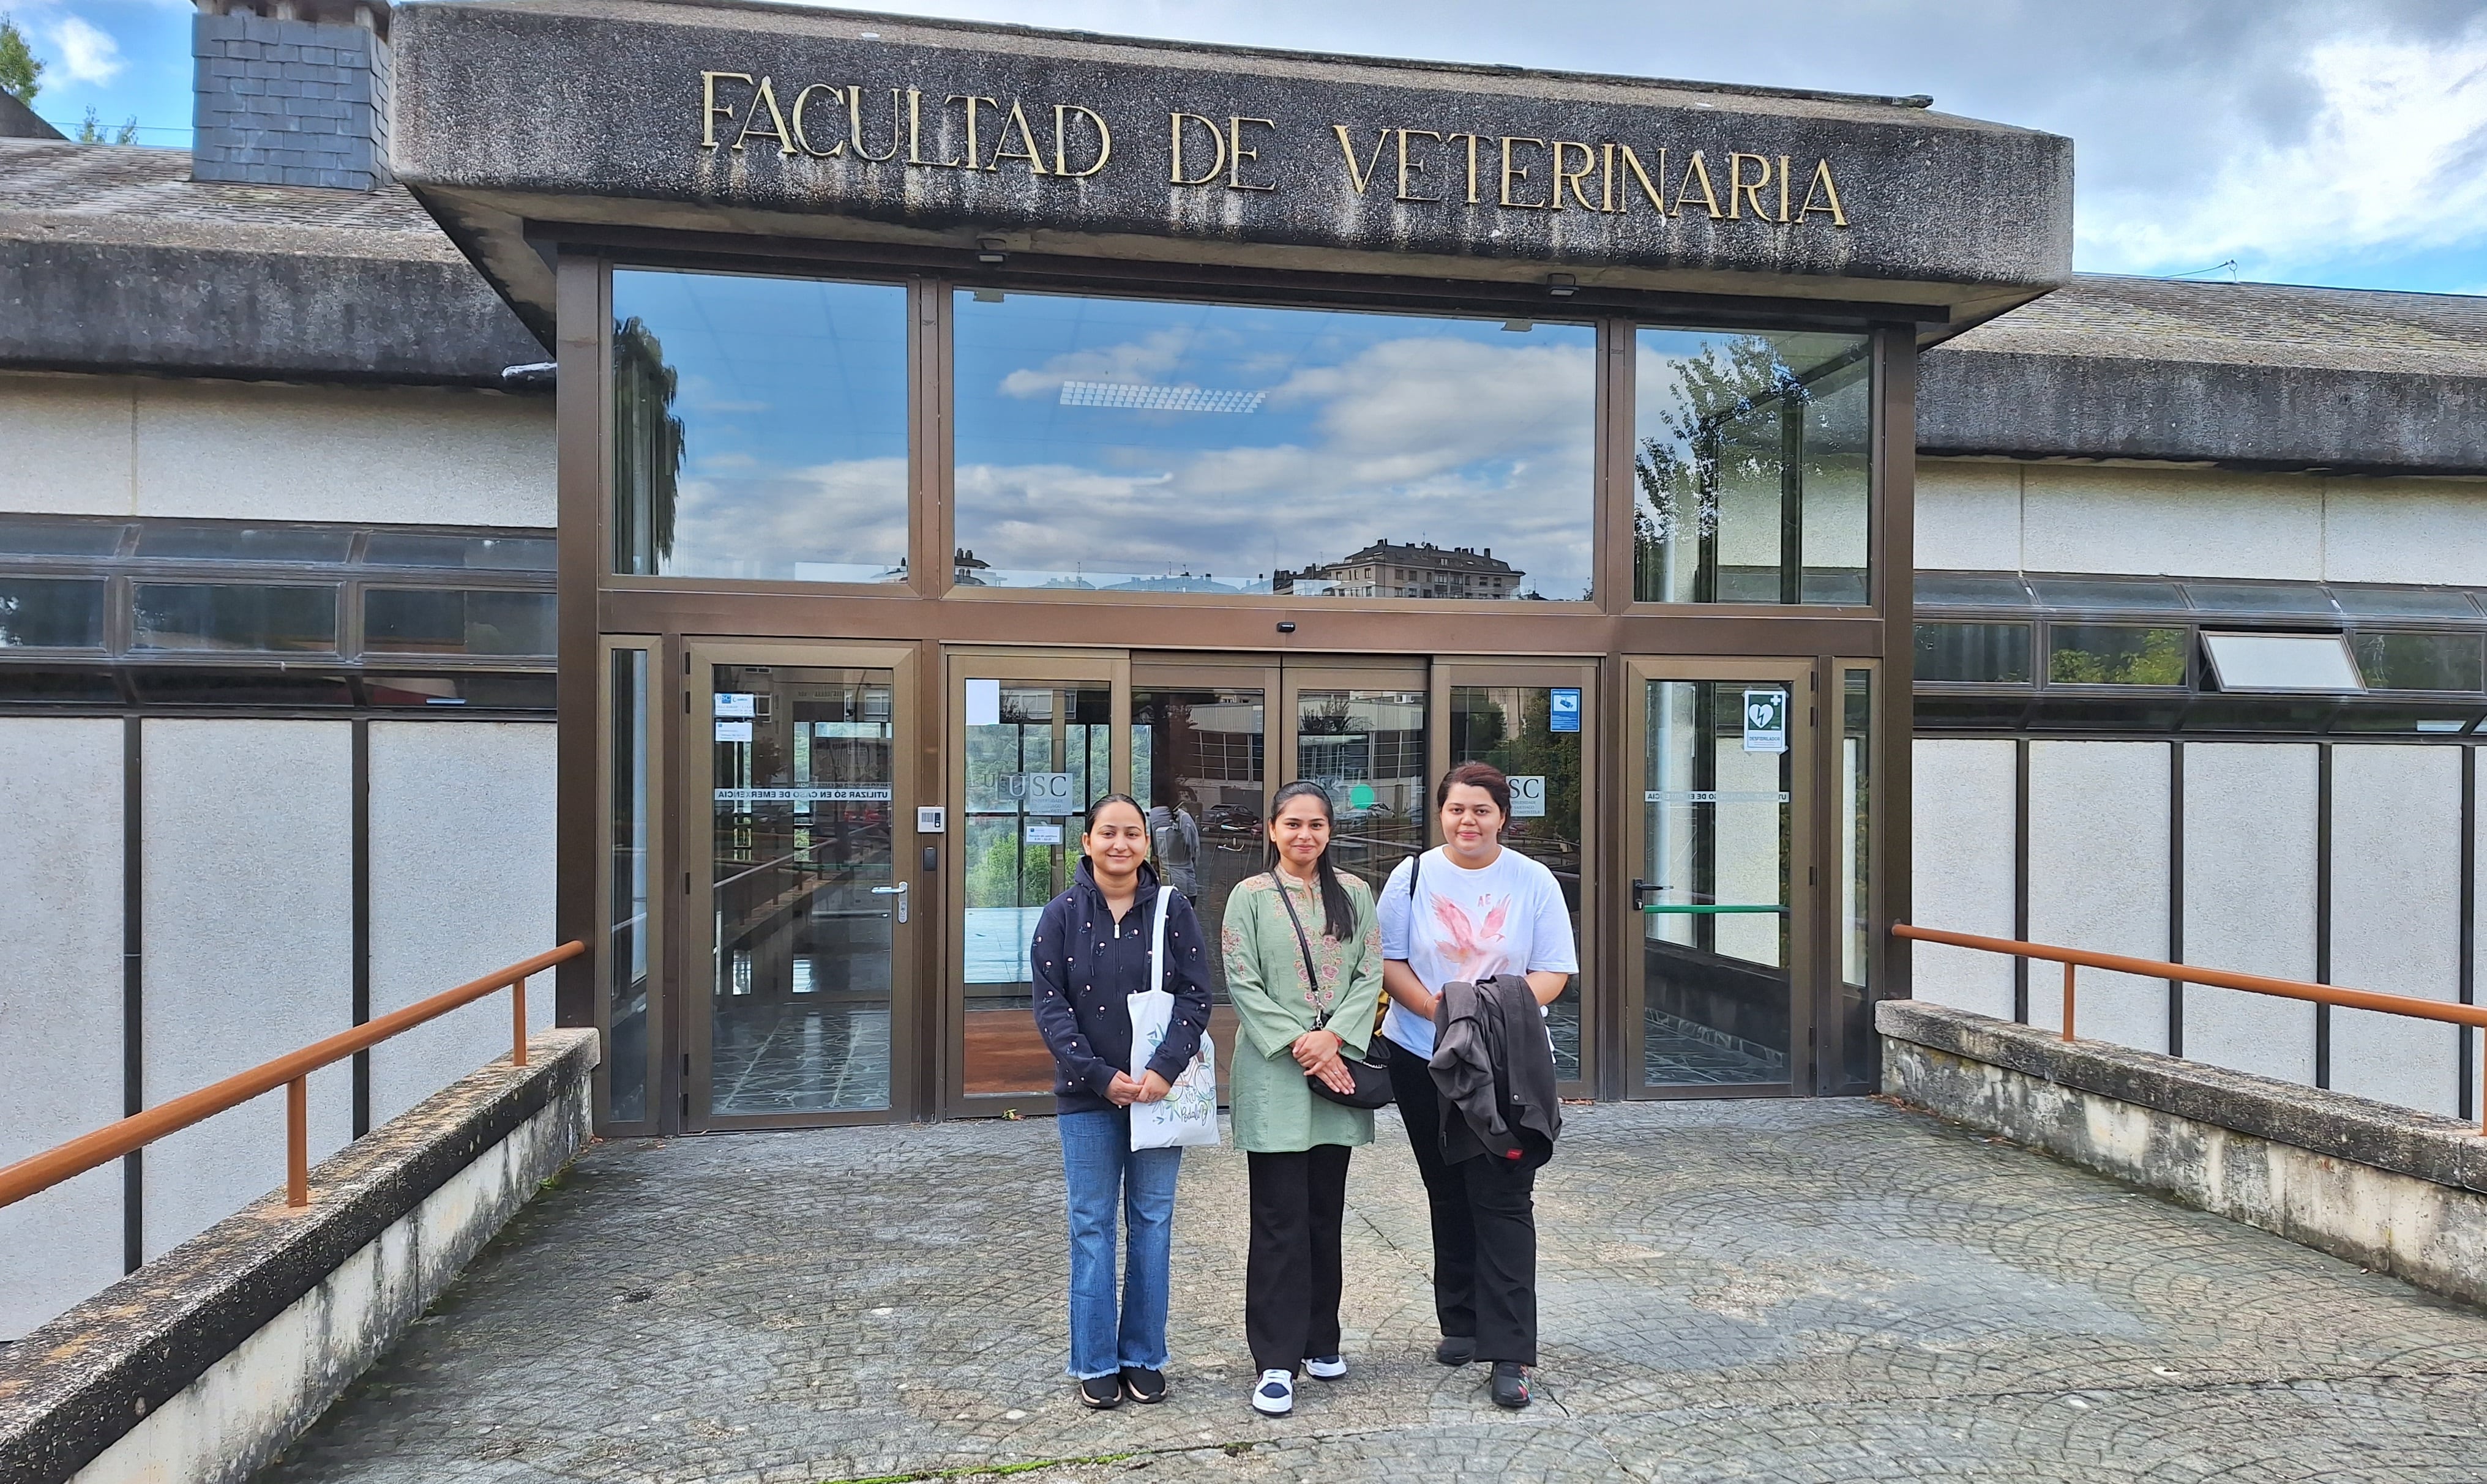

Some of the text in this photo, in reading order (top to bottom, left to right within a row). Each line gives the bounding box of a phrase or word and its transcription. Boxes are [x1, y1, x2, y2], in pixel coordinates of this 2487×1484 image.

[701, 70, 1849, 226] FACULTAD DE VETERINARIA
[1009, 775, 1067, 797] USC
[1508, 778, 1539, 799] SC
